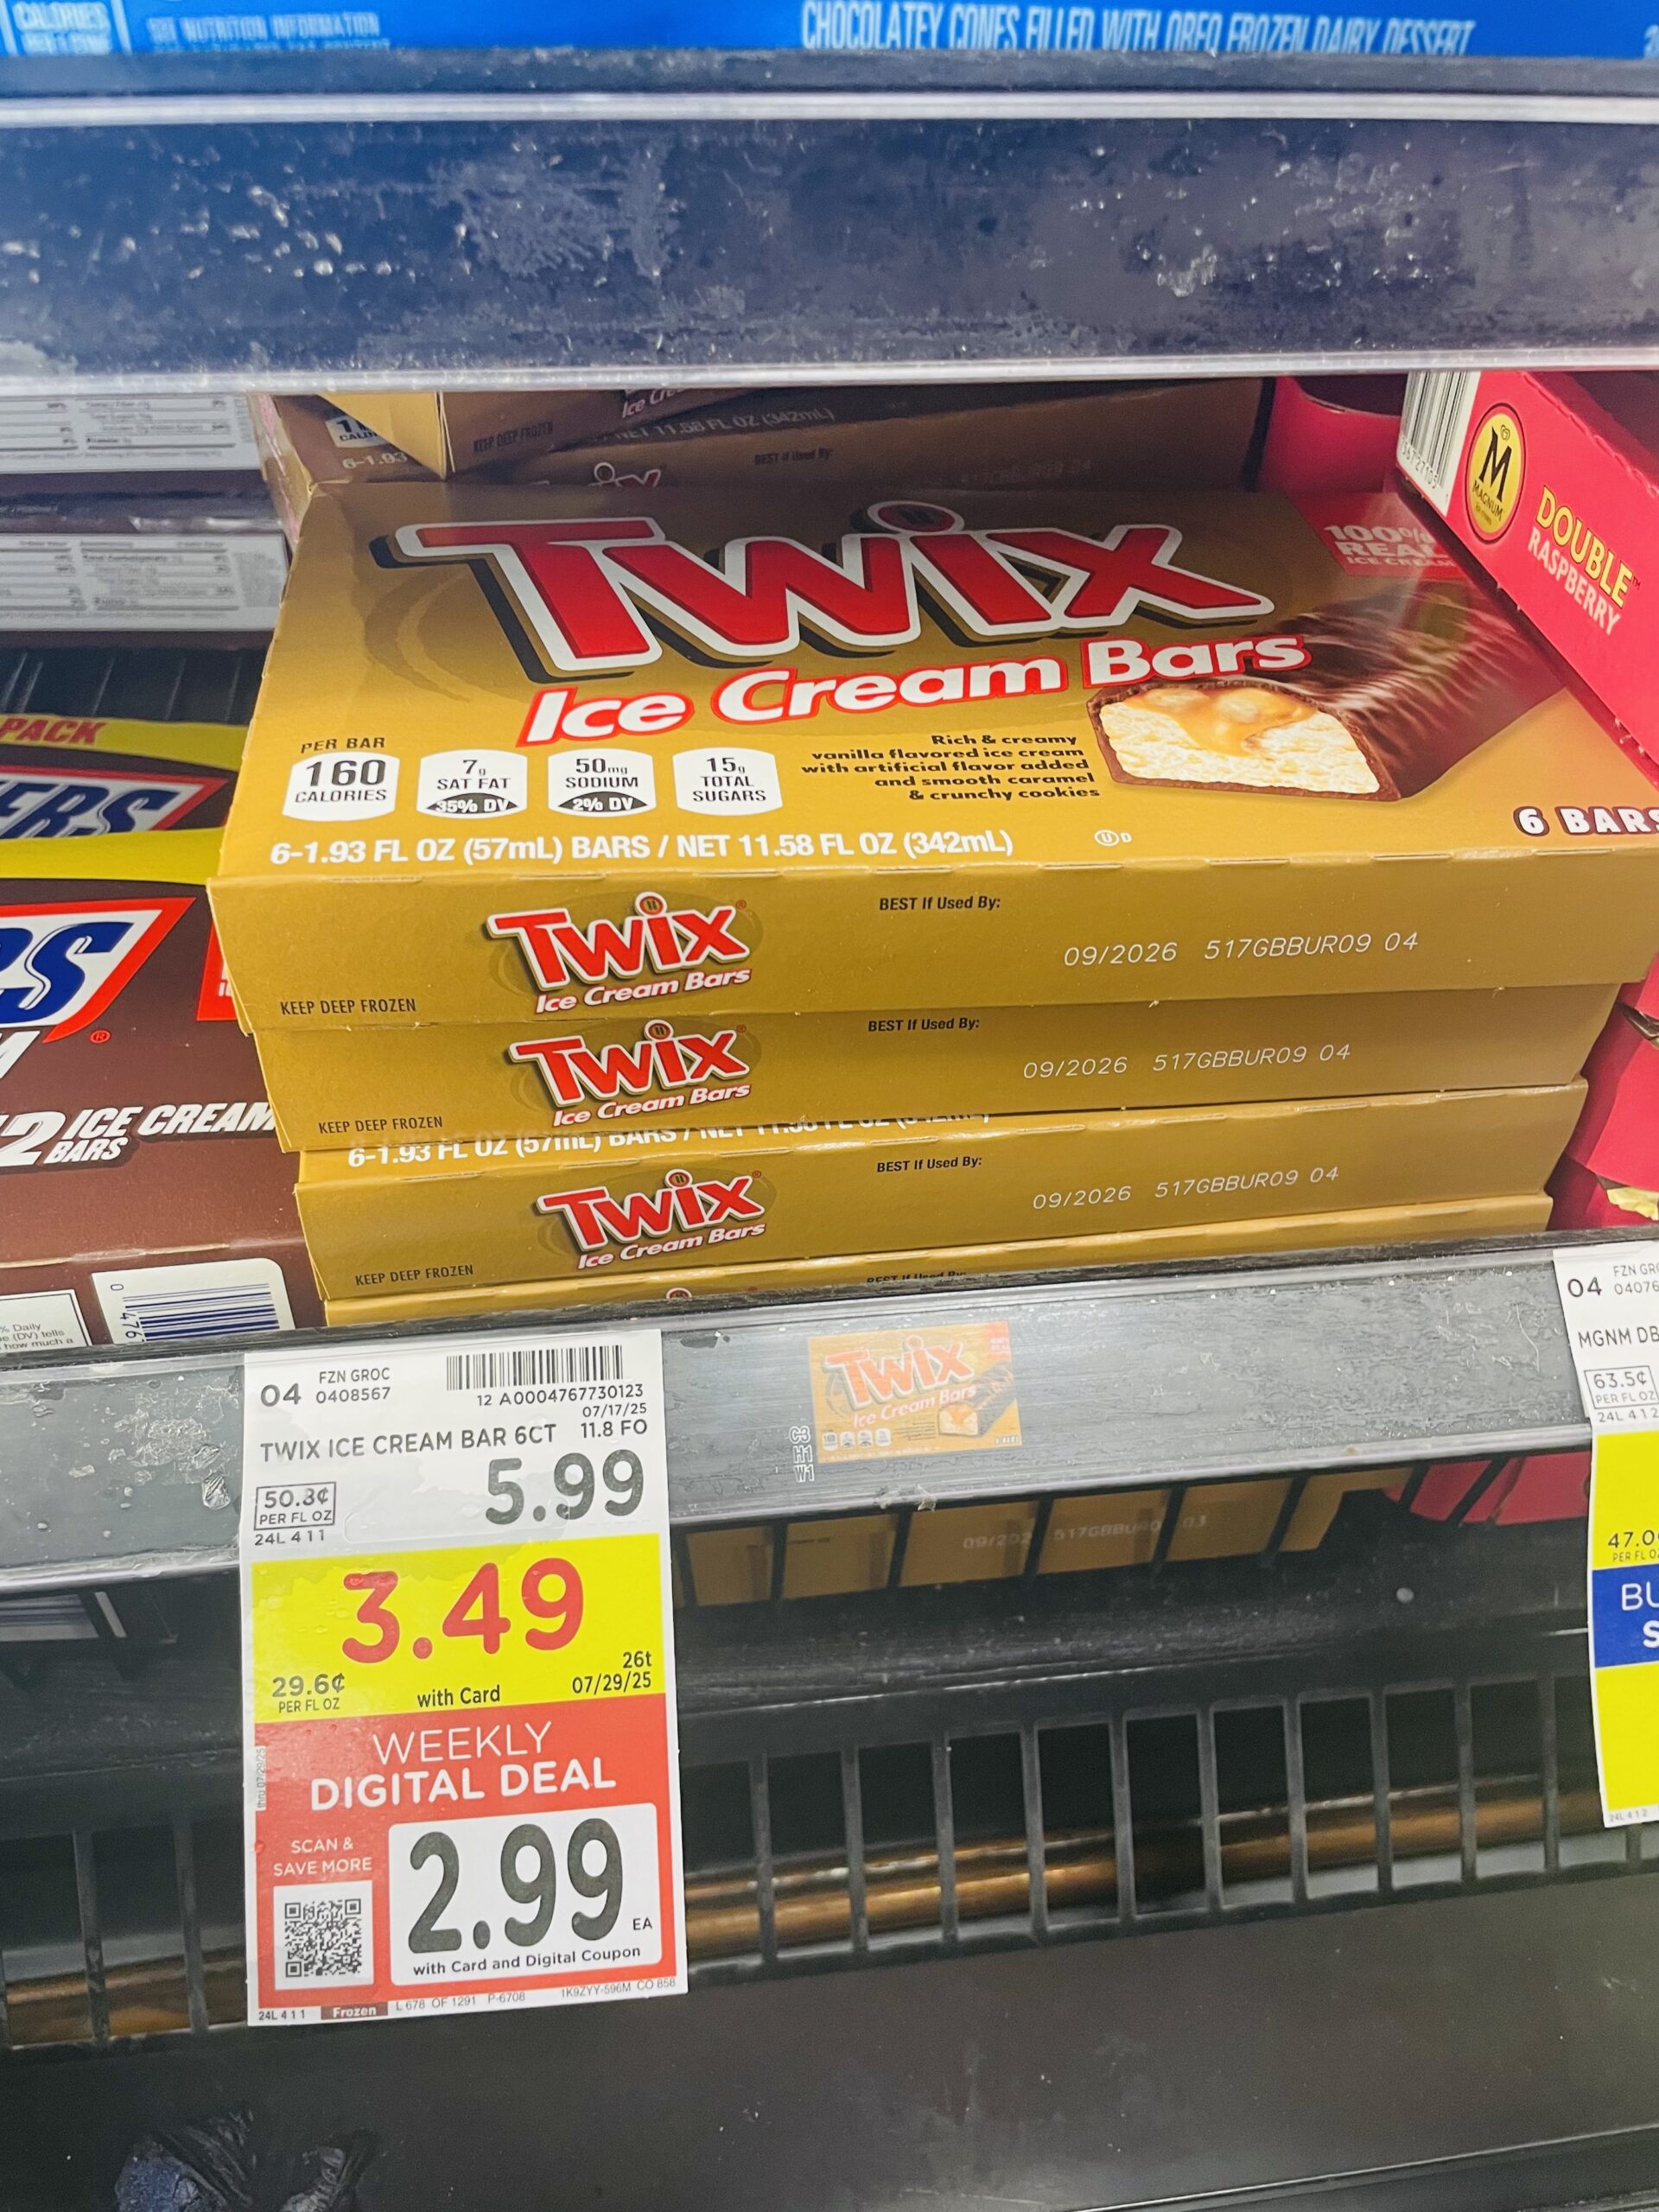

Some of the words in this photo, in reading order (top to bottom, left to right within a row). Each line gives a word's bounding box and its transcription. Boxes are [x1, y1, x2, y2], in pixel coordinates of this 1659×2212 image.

[802, 1, 944, 48] CHOCOLATEY
[950, 4, 1020, 49] CONES
[1103, 10, 1162, 51] WITH
[1471, 480, 1503, 522] MAGNUM
[1324, 524, 1437, 544] 100%
[1334, 541, 1449, 558] REAL
[393, 501, 1277, 672] Twix
[1528, 525, 1621, 636] RASPBERRY
[517, 685, 694, 748] Ice
[711, 654, 1066, 725] Cream
[1084, 632, 1314, 692] Bars
[0, 717, 106, 745] PACK
[931, 734, 976, 745] Rich
[982, 734, 997, 745] &
[1001, 735, 1078, 746] creamy
[301, 739, 338, 753] PER
[346, 736, 385, 750] BAR
[811, 748, 885, 760] vanilla
[889, 747, 980, 759] flavored
[983, 747, 1014, 758] ice
[1018, 748, 1084, 758] cream
[307, 759, 386, 787] 160
[575, 758, 629, 776] 50mg
[706, 757, 747, 774] 15g
[801, 761, 849, 773] with
[854, 760, 947, 773] artificial
[951, 760, 1016, 772] flavor
[1020, 760, 1090, 771] added
[437, 778, 474, 791] SAT
[480, 777, 512, 790] FAT
[565, 776, 639, 789] SODIUM
[701, 776, 754, 787] TOTAL
[874, 775, 916, 786] and
[921, 774, 1001, 785] smooth
[1007, 772, 1095, 785] caramel
[295, 789, 388, 804] CALORIES
[692, 789, 767, 803] SUGARS
[908, 789, 925, 800] &
[930, 787, 1014, 801] crunchy
[1018, 786, 1100, 798] cookies
[483, 798, 512, 813] DV
[572, 798, 605, 812] 2%
[609, 797, 635, 811] DV
[1515, 805, 1549, 836] 6
[270, 840, 366, 865] 6-1.93
[373, 839, 409, 862] FL
[416, 837, 454, 861] OZ
[462, 836, 563, 866] (57mL)
[571, 835, 652, 860] BARS
[677, 834, 731, 858] NET
[738, 833, 815, 858] 11.58
[822, 832, 855, 856] FL
[859, 831, 898, 855] OZ
[903, 830, 1014, 860] (342mL)
[879, 897, 918, 911] BEST
[922, 897, 935, 911] If
[937, 896, 973, 910] Used
[976, 895, 1001, 912] By:
[486, 891, 750, 990] Twix
[1063, 941, 1179, 968] 09/2026
[1383, 931, 1420, 952] 04
[534, 993, 578, 1015] Ice
[583, 977, 680, 1007] Cream
[683, 966, 753, 991] Bars
[280, 1000, 316, 1016] KEEP
[320, 998, 356, 1014] DEEP
[360, 996, 416, 1013] FROZEN
[508, 1020, 752, 1108] Twix
[1022, 1055, 1128, 1080] 09/2026
[1319, 1043, 1351, 1064] 04
[551, 1109, 591, 1127] Ice
[596, 1094, 688, 1121] Cream
[690, 1083, 753, 1105] Bars
[65, 1106, 143, 1139] ICE
[136, 1102, 276, 1136] CREAM
[318, 1120, 351, 1135] KEEP
[355, 1118, 388, 1132] DEEP
[391, 1115, 443, 1130] FROZEN
[44, 1136, 130, 1166] BARS
[536, 1168, 766, 1252] Twix
[1613, 1264, 1637, 1277] FZN
[1567, 1276, 1603, 1298] 04
[1578, 1327, 1632, 1349] MGNM
[319, 1369, 346, 1384] FZN
[350, 1367, 391, 1382] GROC
[823, 1335, 976, 1411] Twix
[1592, 1370, 1648, 1389] 63.5¢
[260, 1382, 302, 1407] 04
[315, 1387, 391, 1405] 0408567
[477, 1394, 493, 1406] 12
[499, 1383, 644, 1407] A0004767730123
[1595, 1394, 1619, 1405] PER
[1623, 1392, 1637, 1402] FL
[1638, 1389, 1656, 1402] OZ
[582, 1402, 648, 1419] 07/17/25
[260, 1439, 321, 1463] TWIX
[328, 1436, 365, 1458] ICE
[372, 1430, 454, 1455] CREAM
[461, 1426, 506, 1449] BAR
[514, 1423, 557, 1445] 6CT
[581, 1421, 613, 1439] 11.8
[620, 1419, 648, 1436] FO
[788, 1424, 810, 1445] C3
[792, 1444, 814, 1464] H1
[794, 1464, 816, 1484] W1
[486, 1448, 645, 1526] 5.99
[258, 1513, 288, 1526] PER
[291, 1511, 308, 1524] FL
[312, 1509, 333, 1522] OZ
[254, 1531, 286, 1547] 24L
[342, 1557, 584, 1664] 3.49
[622, 1650, 652, 1669] 26t
[572, 1671, 652, 1694] 07/29/25
[278, 1700, 303, 1713] PER
[305, 1698, 320, 1712] FL
[322, 1696, 340, 1710] OZ
[416, 1691, 454, 1709] with
[460, 1684, 501, 1705] Card
[372, 1720, 552, 1765] WEEKLY
[311, 1766, 485, 1812] DIGITAL
[500, 1757, 617, 1797] DEAL
[290, 1839, 338, 1855] SCAN
[342, 1837, 353, 1851] &
[273, 1859, 317, 1878] SAVE
[321, 1857, 373, 1874] MORE
[408, 1818, 623, 1955] 2.99
[632, 1916, 652, 1932] EA
[413, 1961, 446, 1976] with
[451, 1958, 487, 1974] Card
[493, 1955, 520, 1971] and
[525, 1950, 576, 1970] Digital
[582, 1946, 641, 1966] Coupon
[637, 1979, 654, 1992] CO
[656, 1977, 677, 1990] 858
[332, 2005, 377, 2018] Frozen
[405, 2000, 426, 2012] 678
[431, 1998, 448, 2009] OF
[452, 1995, 476, 2007] 1291
[487, 1992, 525, 2005] P-6708
